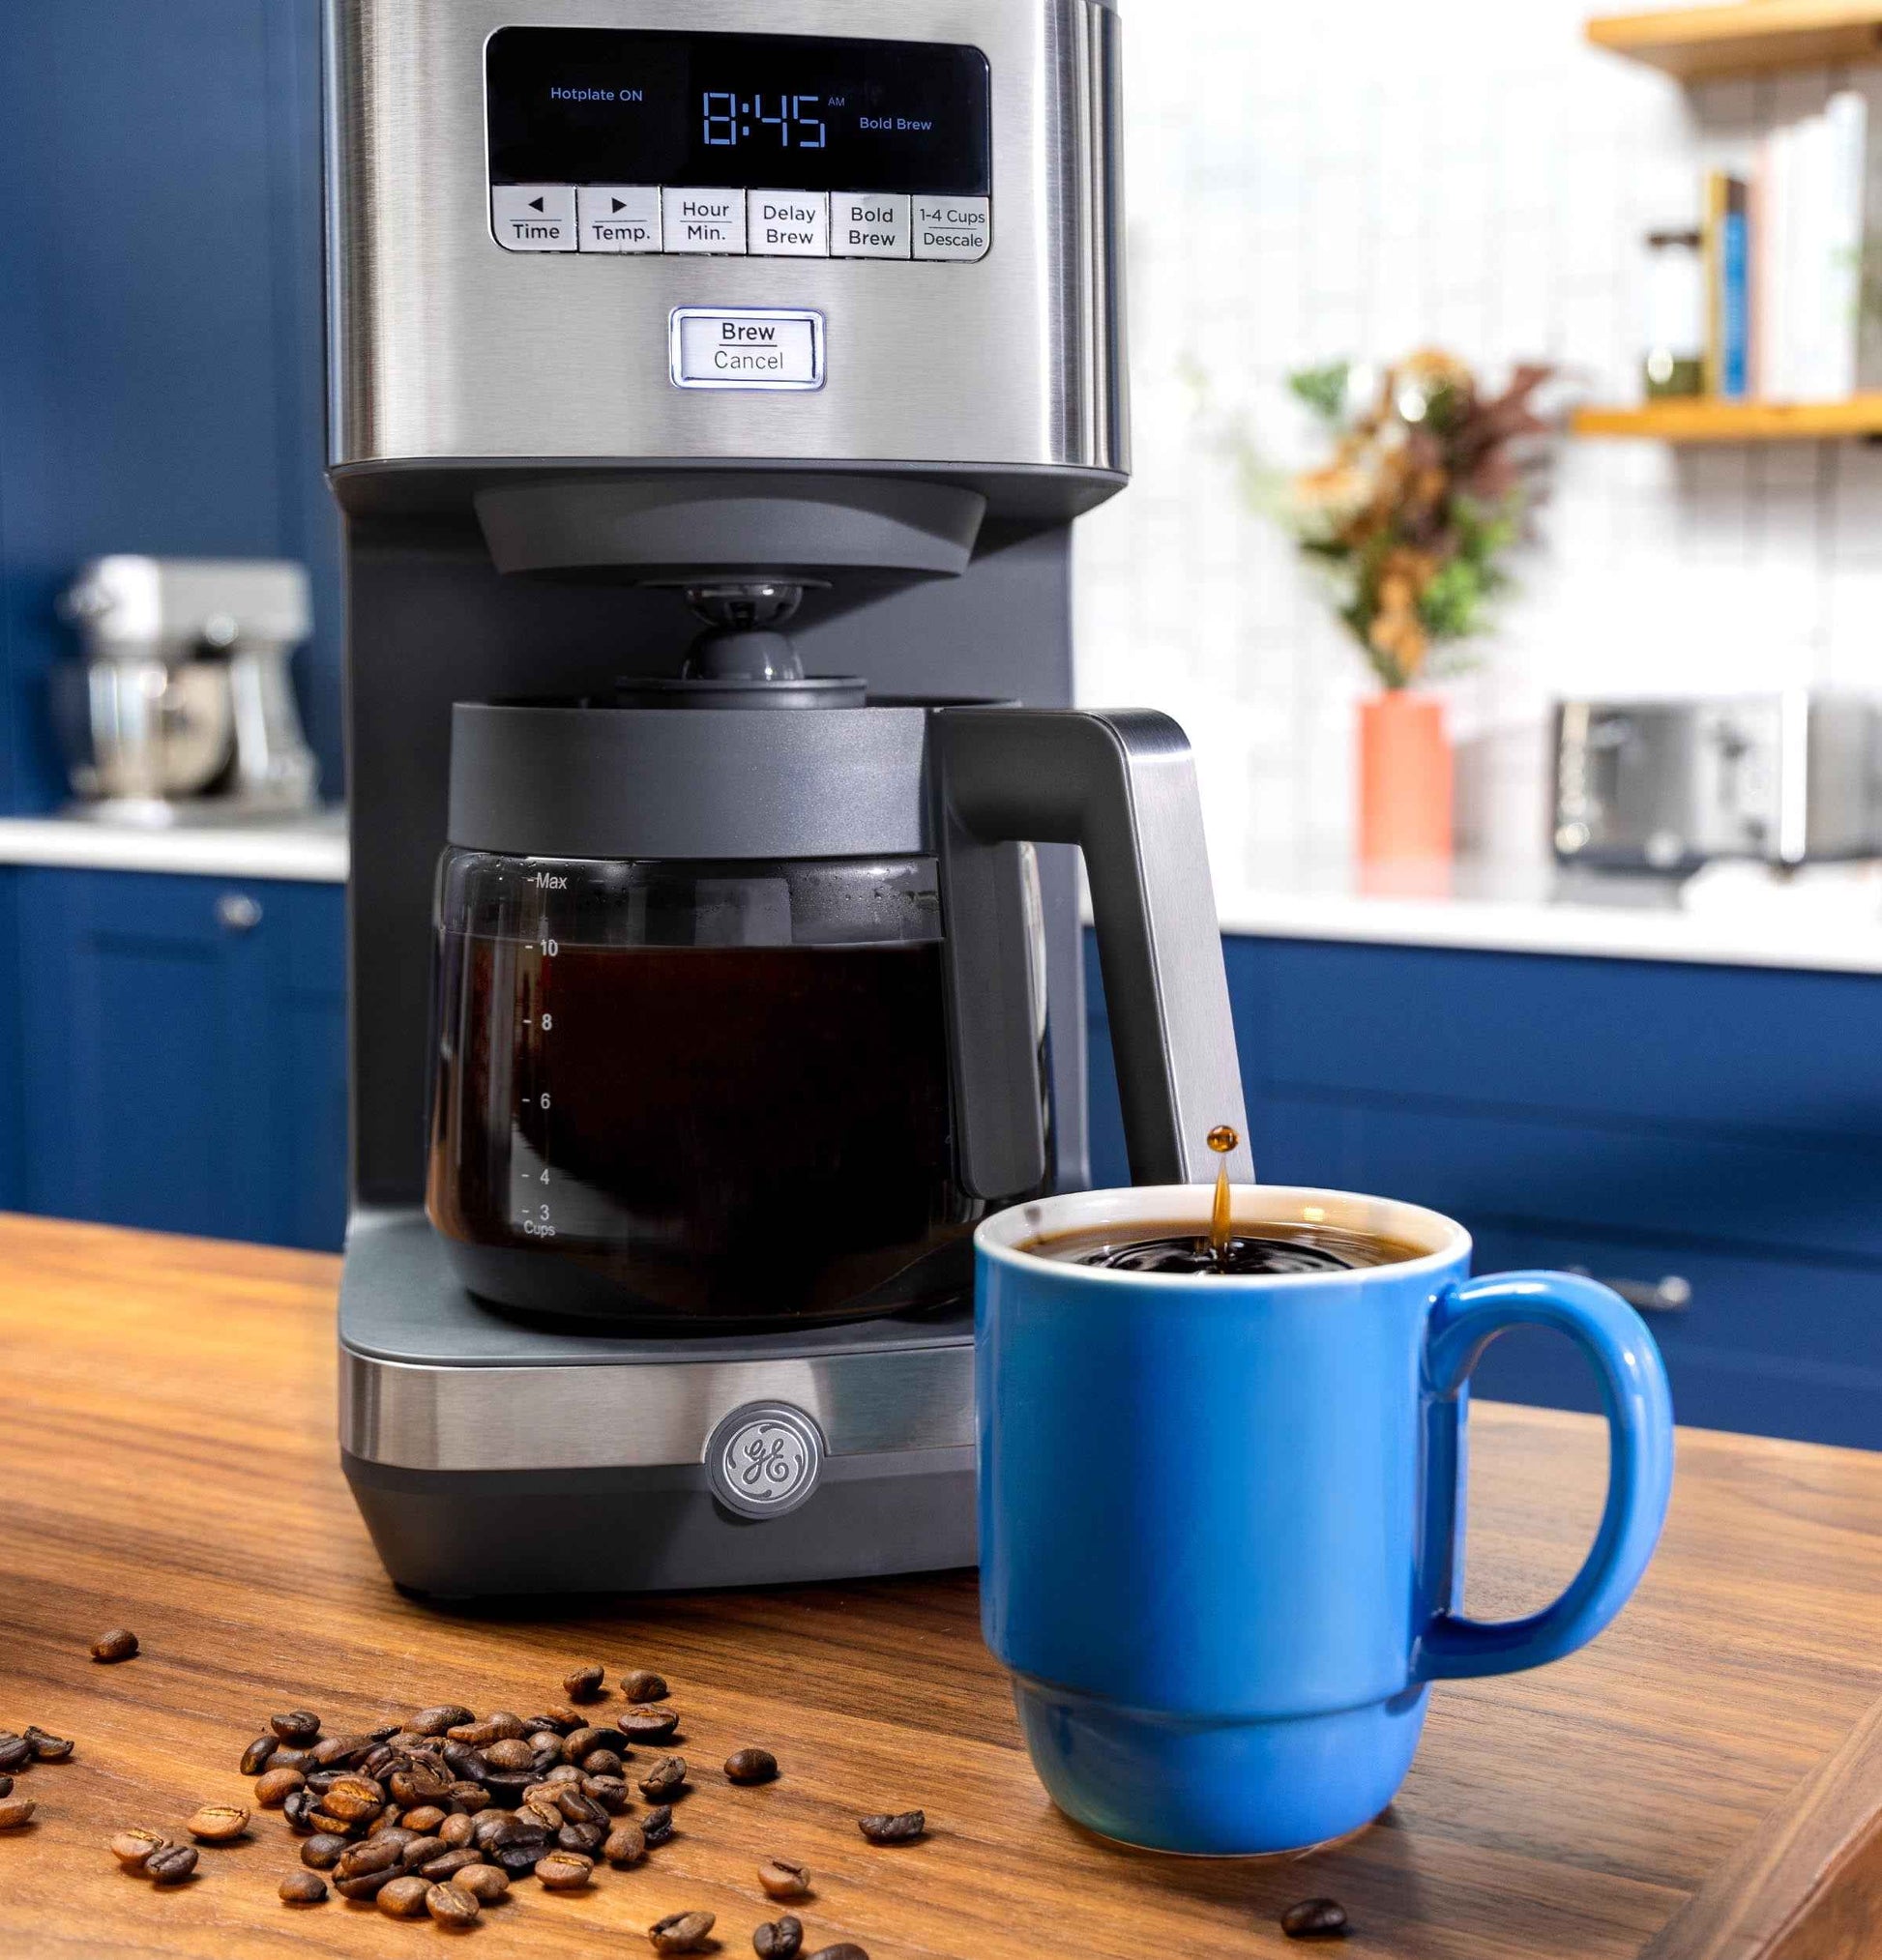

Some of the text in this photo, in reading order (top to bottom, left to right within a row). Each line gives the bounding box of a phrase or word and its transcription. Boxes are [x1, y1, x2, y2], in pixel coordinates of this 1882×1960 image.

[550, 87, 643, 102] Hotplate ON
[703, 92, 845, 148] 8:45 AM
[859, 117, 932, 131] Bold Brew
[683, 201, 729, 217] Hour
[763, 205, 816, 224] Delay
[851, 207, 894, 222] Bold
[919, 208, 985, 224] 1-4 Cups
[512, 224, 560, 239] Time
[592, 225, 651, 242] Temp.
[688, 225, 726, 240] Min.
[766, 229, 813, 244] Brew
[849, 230, 896, 246] Brew
[924, 232, 984, 248] Descale
[721, 322, 776, 340] Brew
[714, 350, 783, 369] Cancel
[536, 872, 568, 890] Max
[540, 939, 559, 956] 10
[542, 1013, 552, 1031] 8
[540, 1093, 551, 1109] 6
[540, 1168, 549, 1185] 4
[540, 1204, 549, 1220] 3
[523, 1219, 556, 1238] Cups
